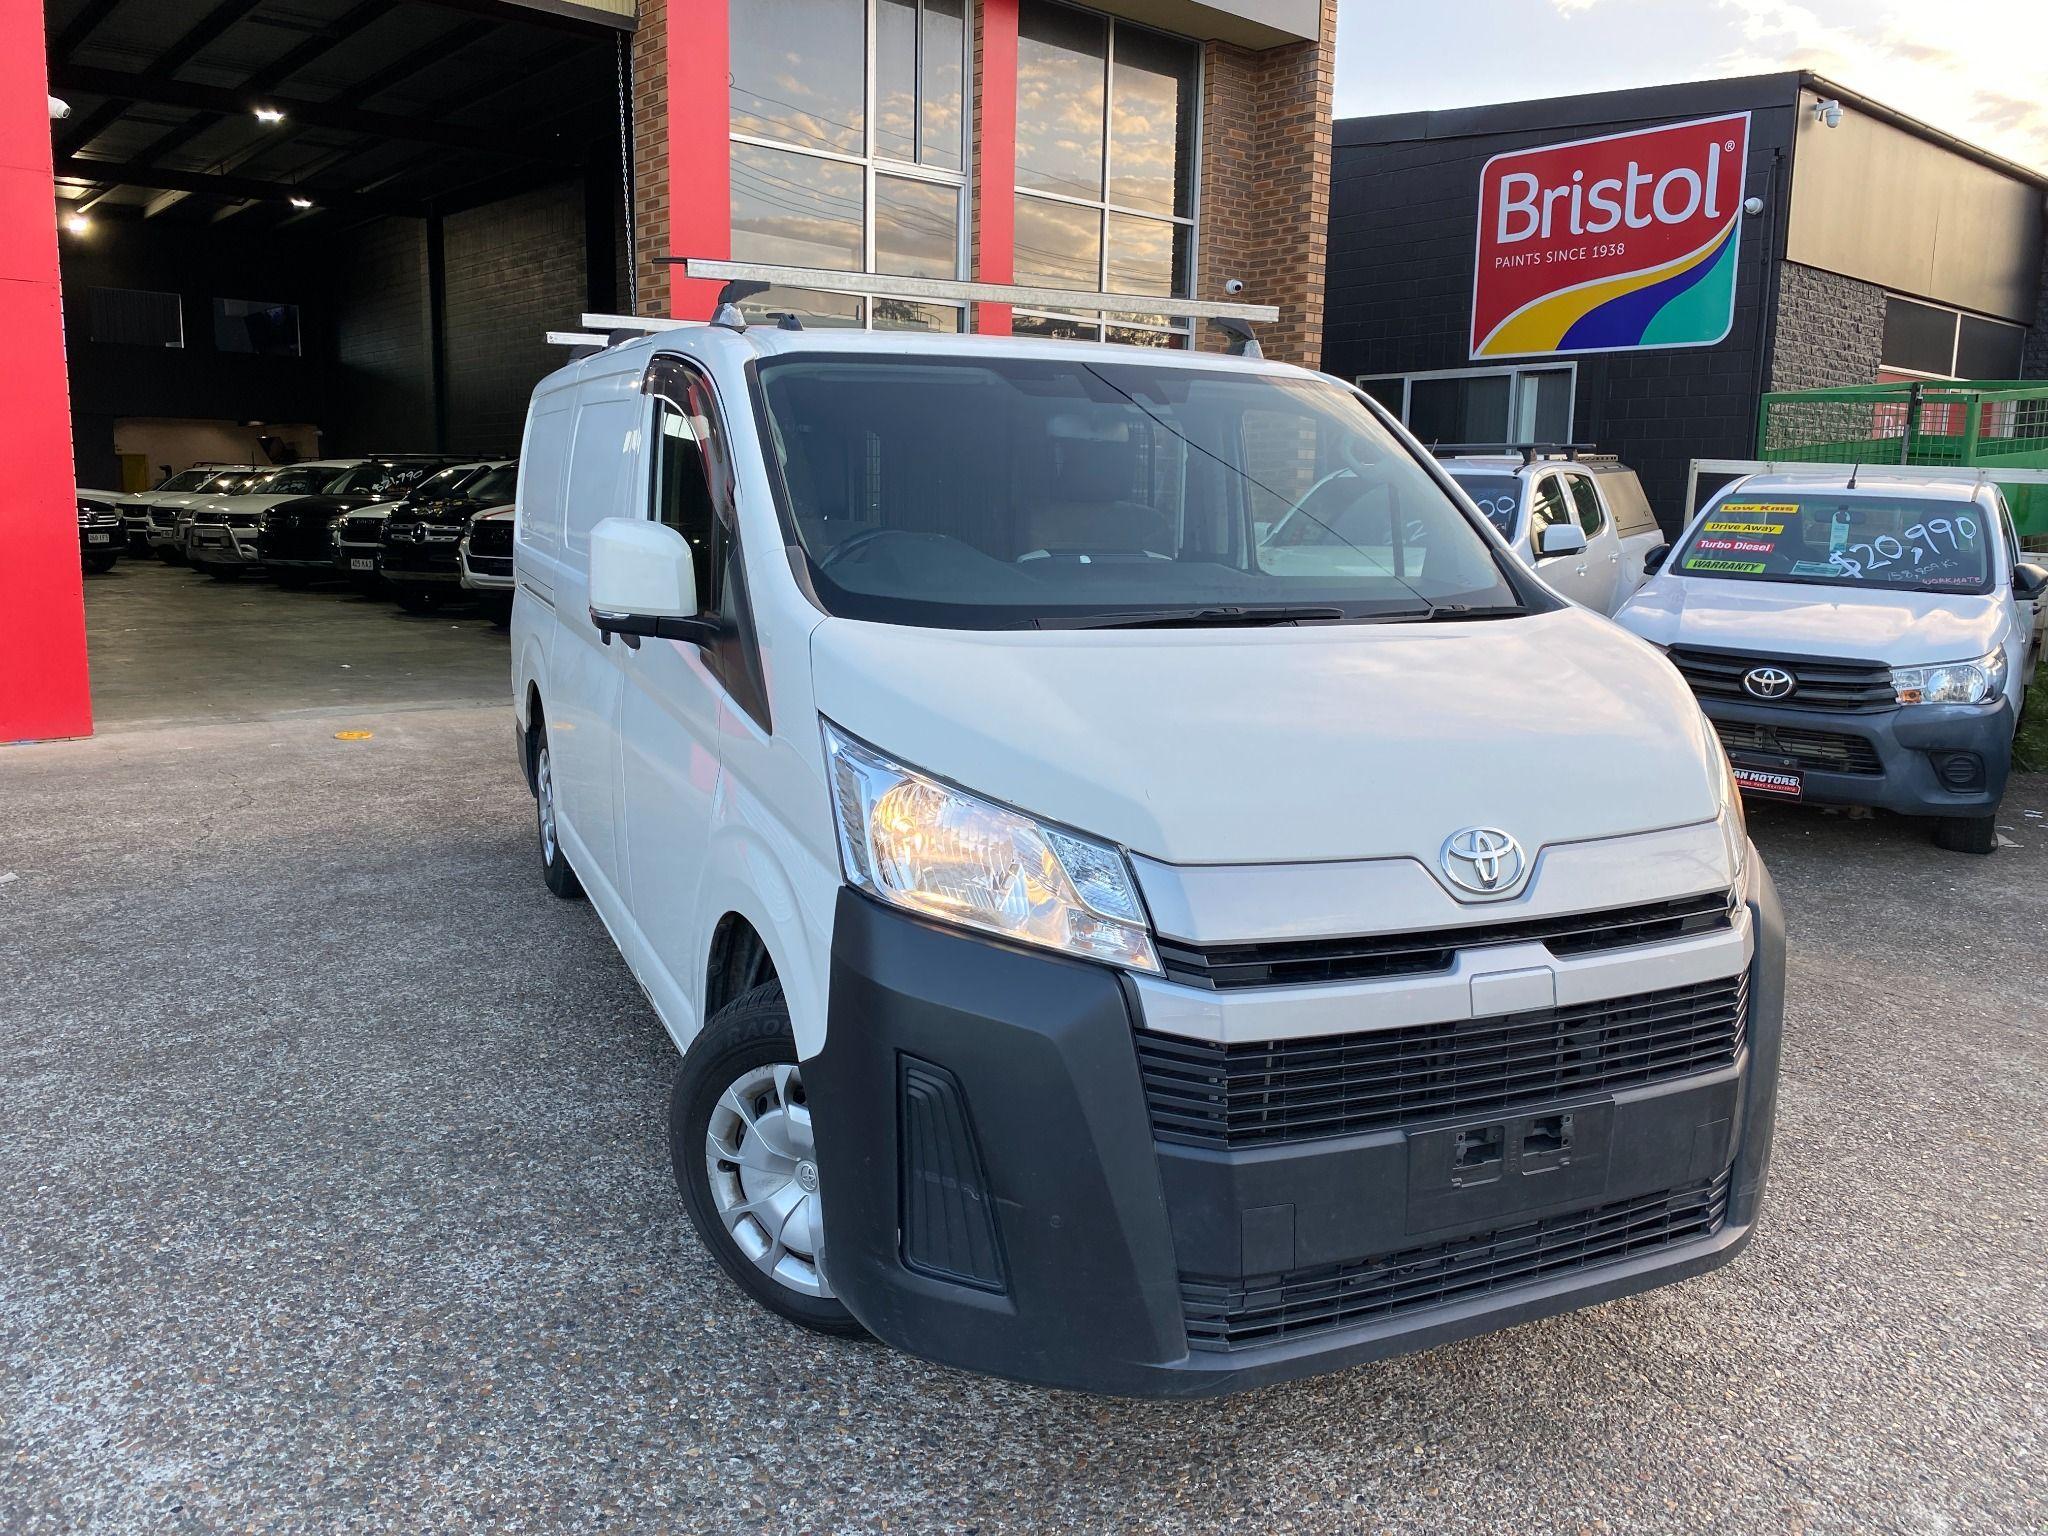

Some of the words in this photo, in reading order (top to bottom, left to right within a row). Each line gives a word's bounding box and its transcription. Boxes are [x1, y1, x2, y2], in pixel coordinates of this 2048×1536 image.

[1497, 143, 1721, 243] Bristol
[1495, 252, 1541, 268] PAINTS
[1546, 247, 1586, 263] SINCE
[1592, 243, 1625, 258] 1938
[1723, 504, 1756, 512] Low
[1759, 505, 1795, 513] Kms
[1711, 523, 1741, 531] Drive
[1743, 524, 1776, 534] Away
[1700, 540, 1732, 550] Turbo
[1733, 542, 1772, 552] Diesel
[1829, 516, 1977, 579] $20,990
[1692, 559, 1762, 572] WARRANTY
[1749, 772, 1797, 786] MOTORS
